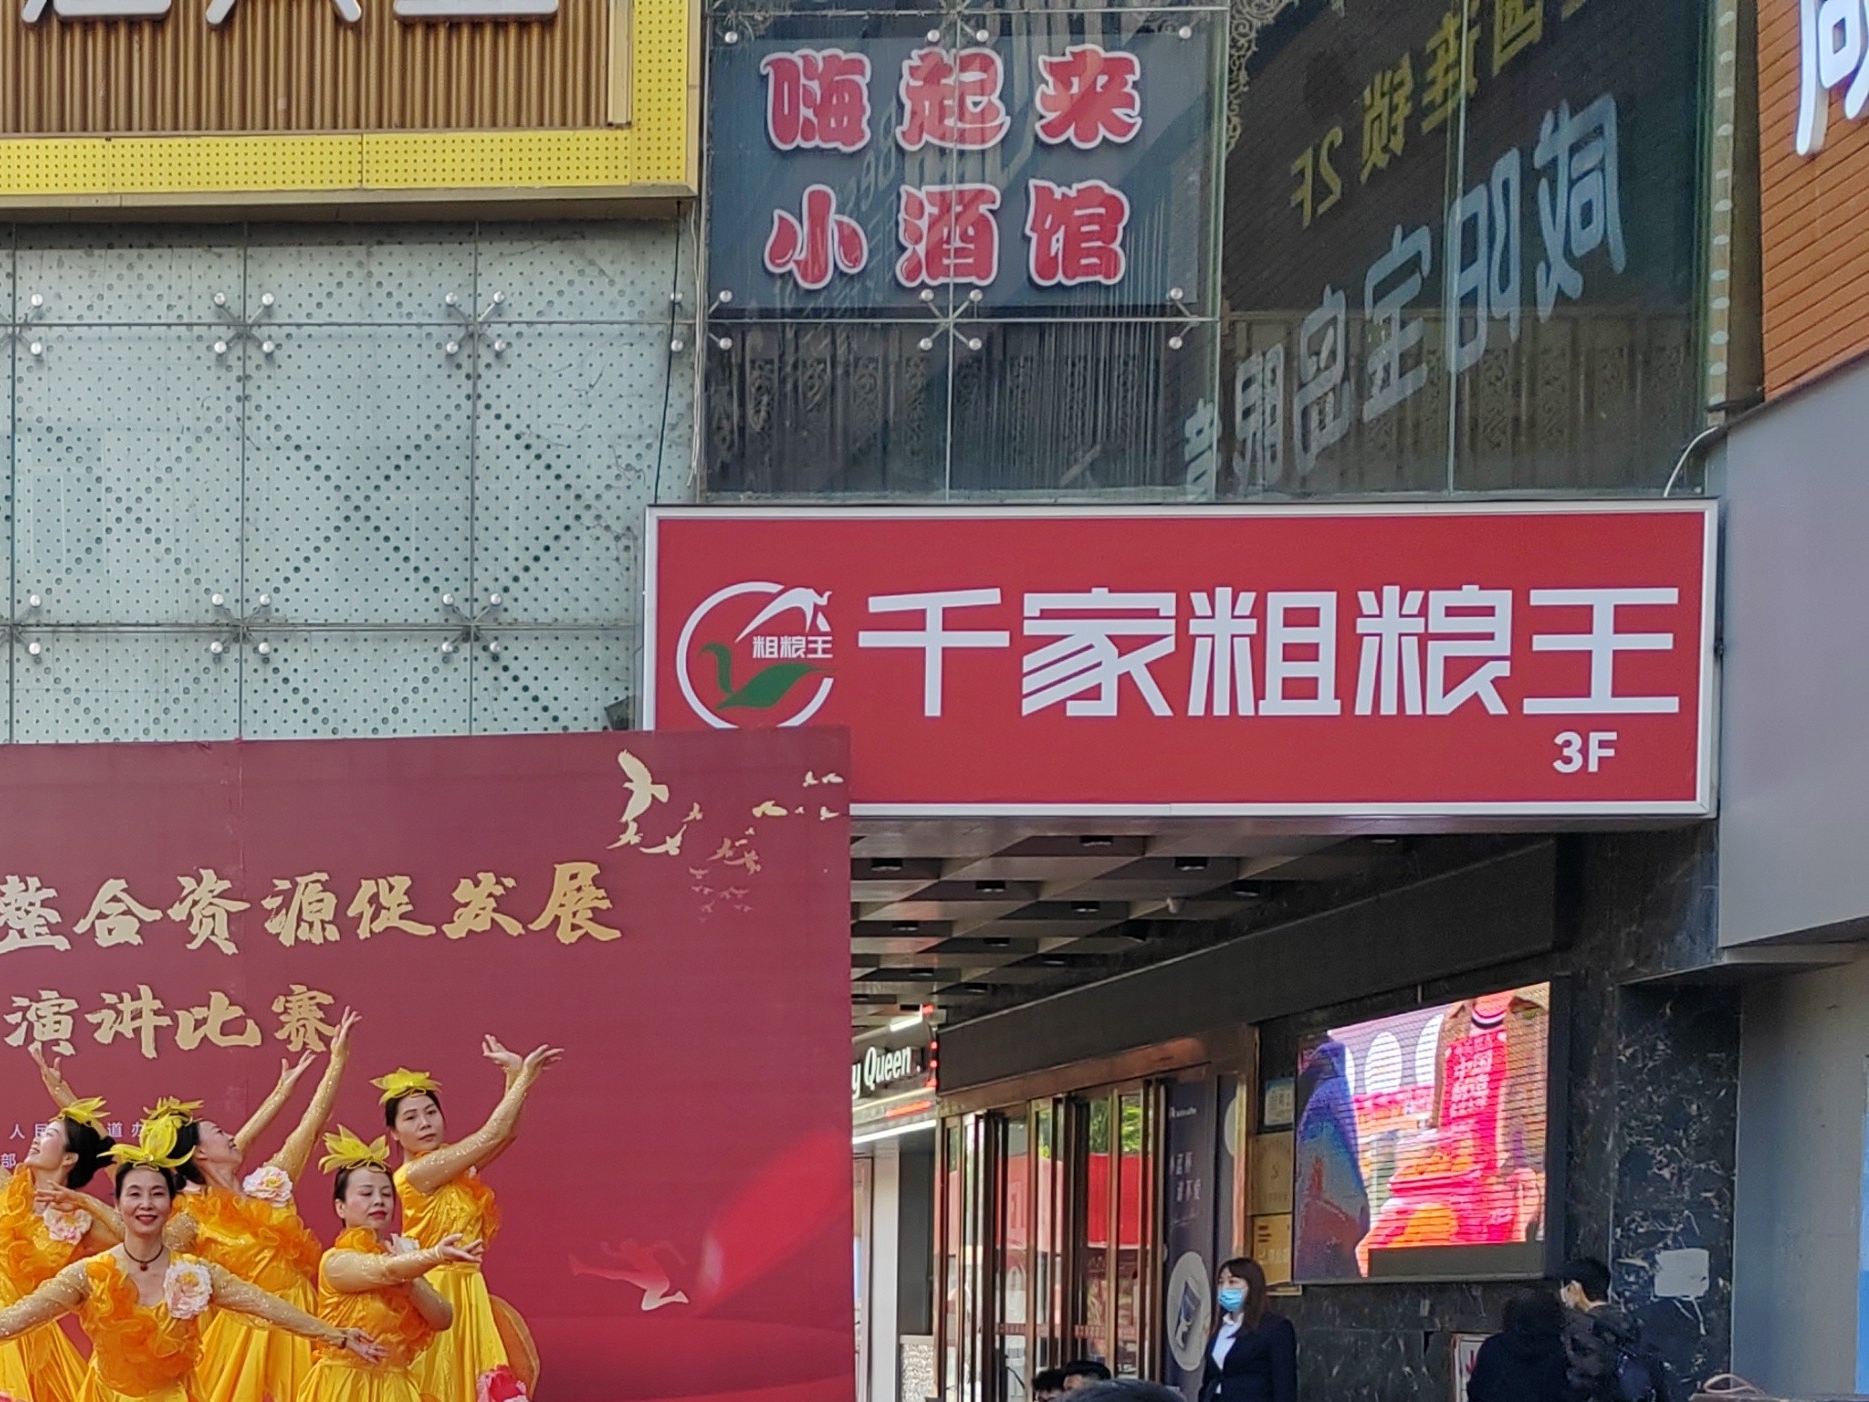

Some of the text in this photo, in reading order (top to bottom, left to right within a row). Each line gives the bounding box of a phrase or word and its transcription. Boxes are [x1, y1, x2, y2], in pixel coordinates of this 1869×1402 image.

[761, 43, 1142, 151] 嗨起来
[763, 180, 1131, 290] 小酒馆
[752, 635, 834, 659] 粗粮王
[858, 584, 1681, 717] 千家粗粮王
[1552, 731, 1619, 774] 3F
[864, 1046, 912, 1091] Queen
